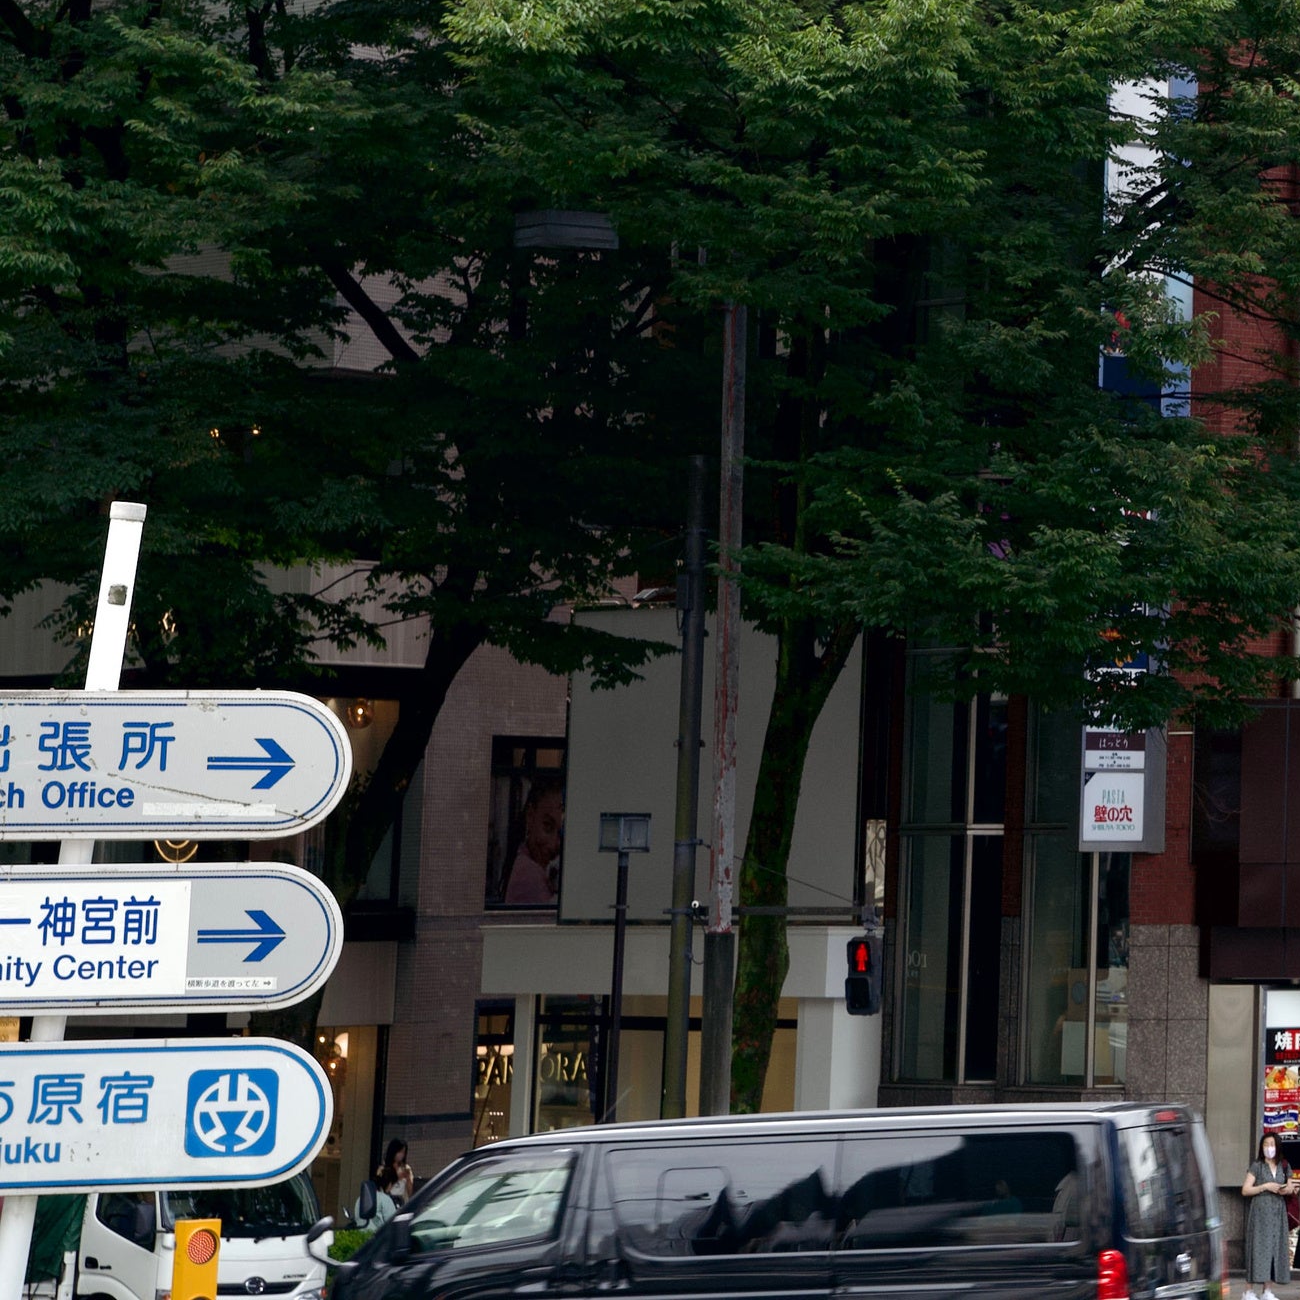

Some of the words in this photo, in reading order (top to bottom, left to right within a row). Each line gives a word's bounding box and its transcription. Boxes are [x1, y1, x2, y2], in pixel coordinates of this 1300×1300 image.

[0, 721, 176, 772] 張所
[1099, 738, 1129, 749] はっとり
[41, 781, 135, 809] Office
[1102, 789, 1126, 805] PASTA
[1094, 805, 1133, 822] 壁の穴
[52, 954, 159, 980] Center
